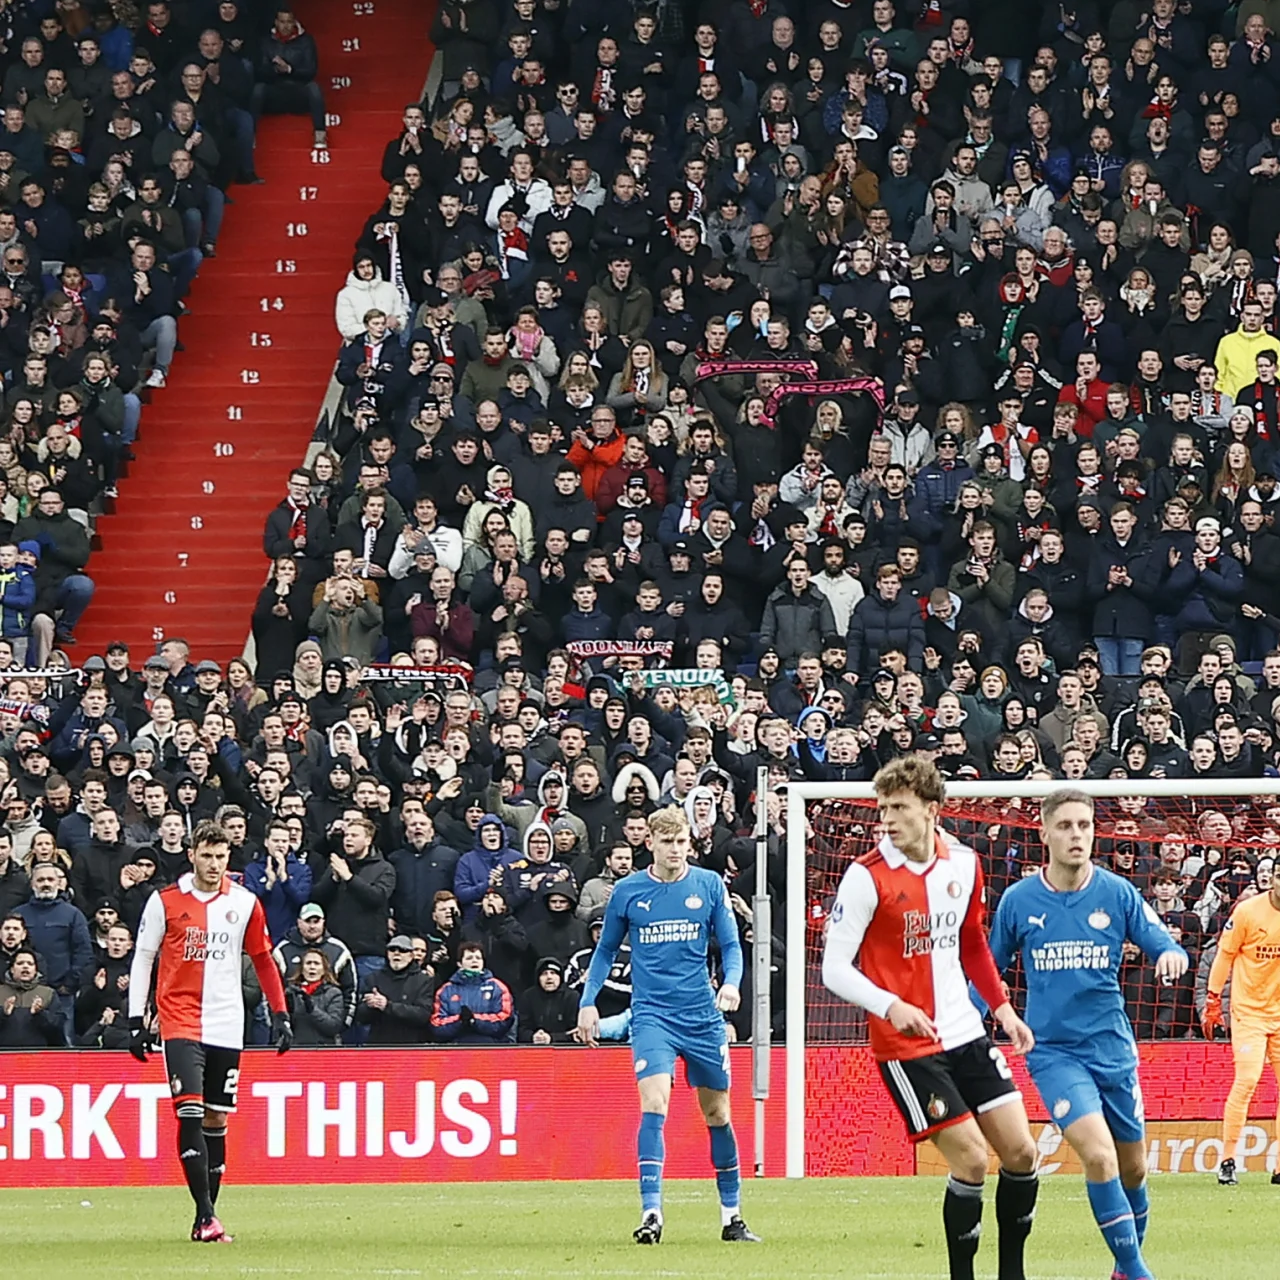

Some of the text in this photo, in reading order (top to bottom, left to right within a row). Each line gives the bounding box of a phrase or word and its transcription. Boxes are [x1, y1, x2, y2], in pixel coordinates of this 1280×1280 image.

[904, 909, 957, 934] Euro
[186, 926, 229, 944] Euro
[903, 933, 957, 958] Parcs
[184, 944, 226, 961] Parcs
[252, 1080, 519, 1159] THIJS!
